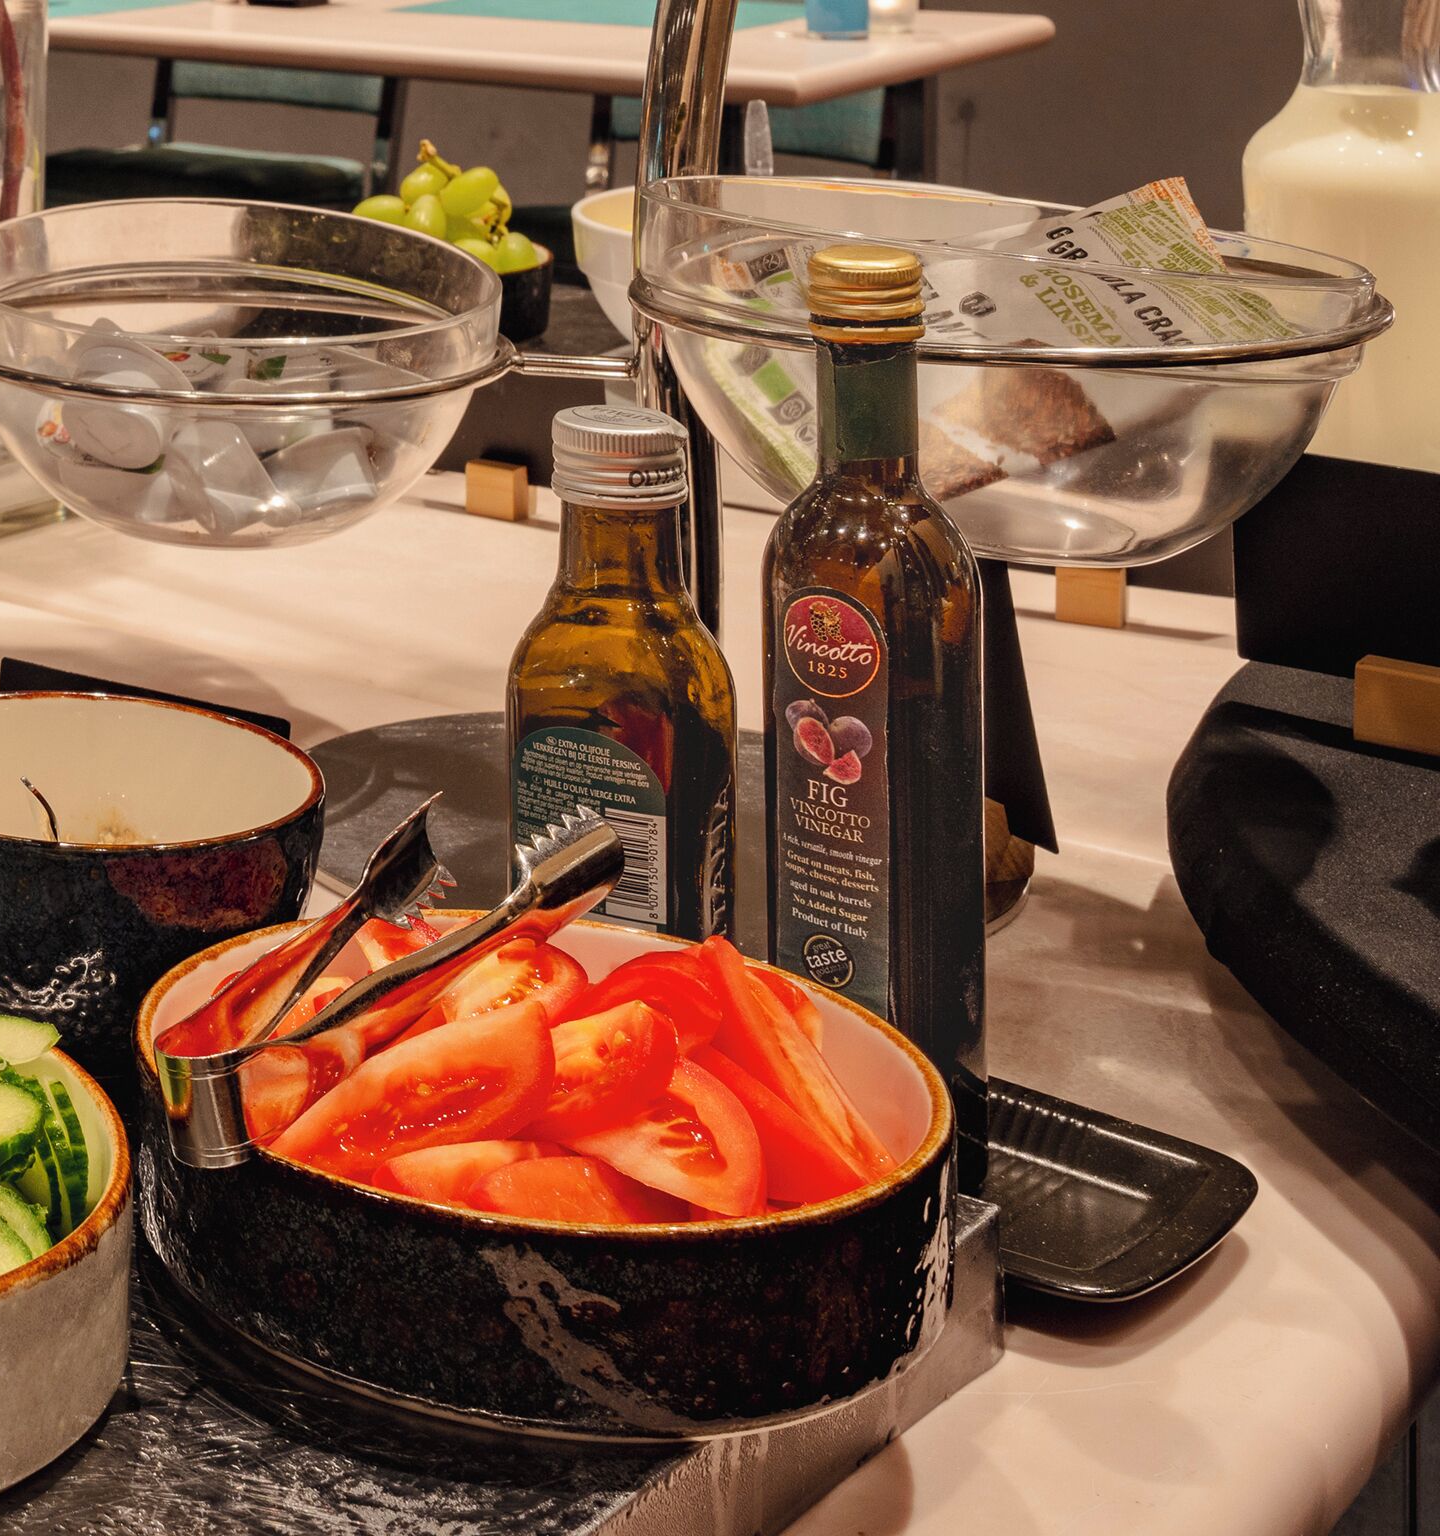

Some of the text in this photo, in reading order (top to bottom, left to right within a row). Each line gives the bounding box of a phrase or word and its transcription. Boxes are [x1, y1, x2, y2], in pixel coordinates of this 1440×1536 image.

[787, 624, 873, 665] Vincotto
[808, 661, 848, 679] 1825
[533, 741, 568, 756] VERKREGEN
[612, 759, 641, 771] PERSING
[558, 739, 578, 750] EXTRA
[544, 778, 637, 805] HUILE D'OLIVE VIERGE EXTRA
[807, 779, 848, 807] FIG
[790, 797, 870, 828] VINCOTTO
[649, 822, 658, 862] 901784
[794, 813, 864, 843] VINEGAR
[787, 850, 809, 865] Great
[811, 860, 821, 868] on
[829, 848, 853, 861] smooth
[855, 854, 882, 867] vinegar
[649, 868, 658, 907] 007150
[790, 879, 872, 909] aged in oak barrels
[841, 878, 879, 893] desserts
[792, 893, 868, 923] No Added Sugar
[792, 907, 868, 939] Product of Italy
[806, 949, 848, 969] taste
